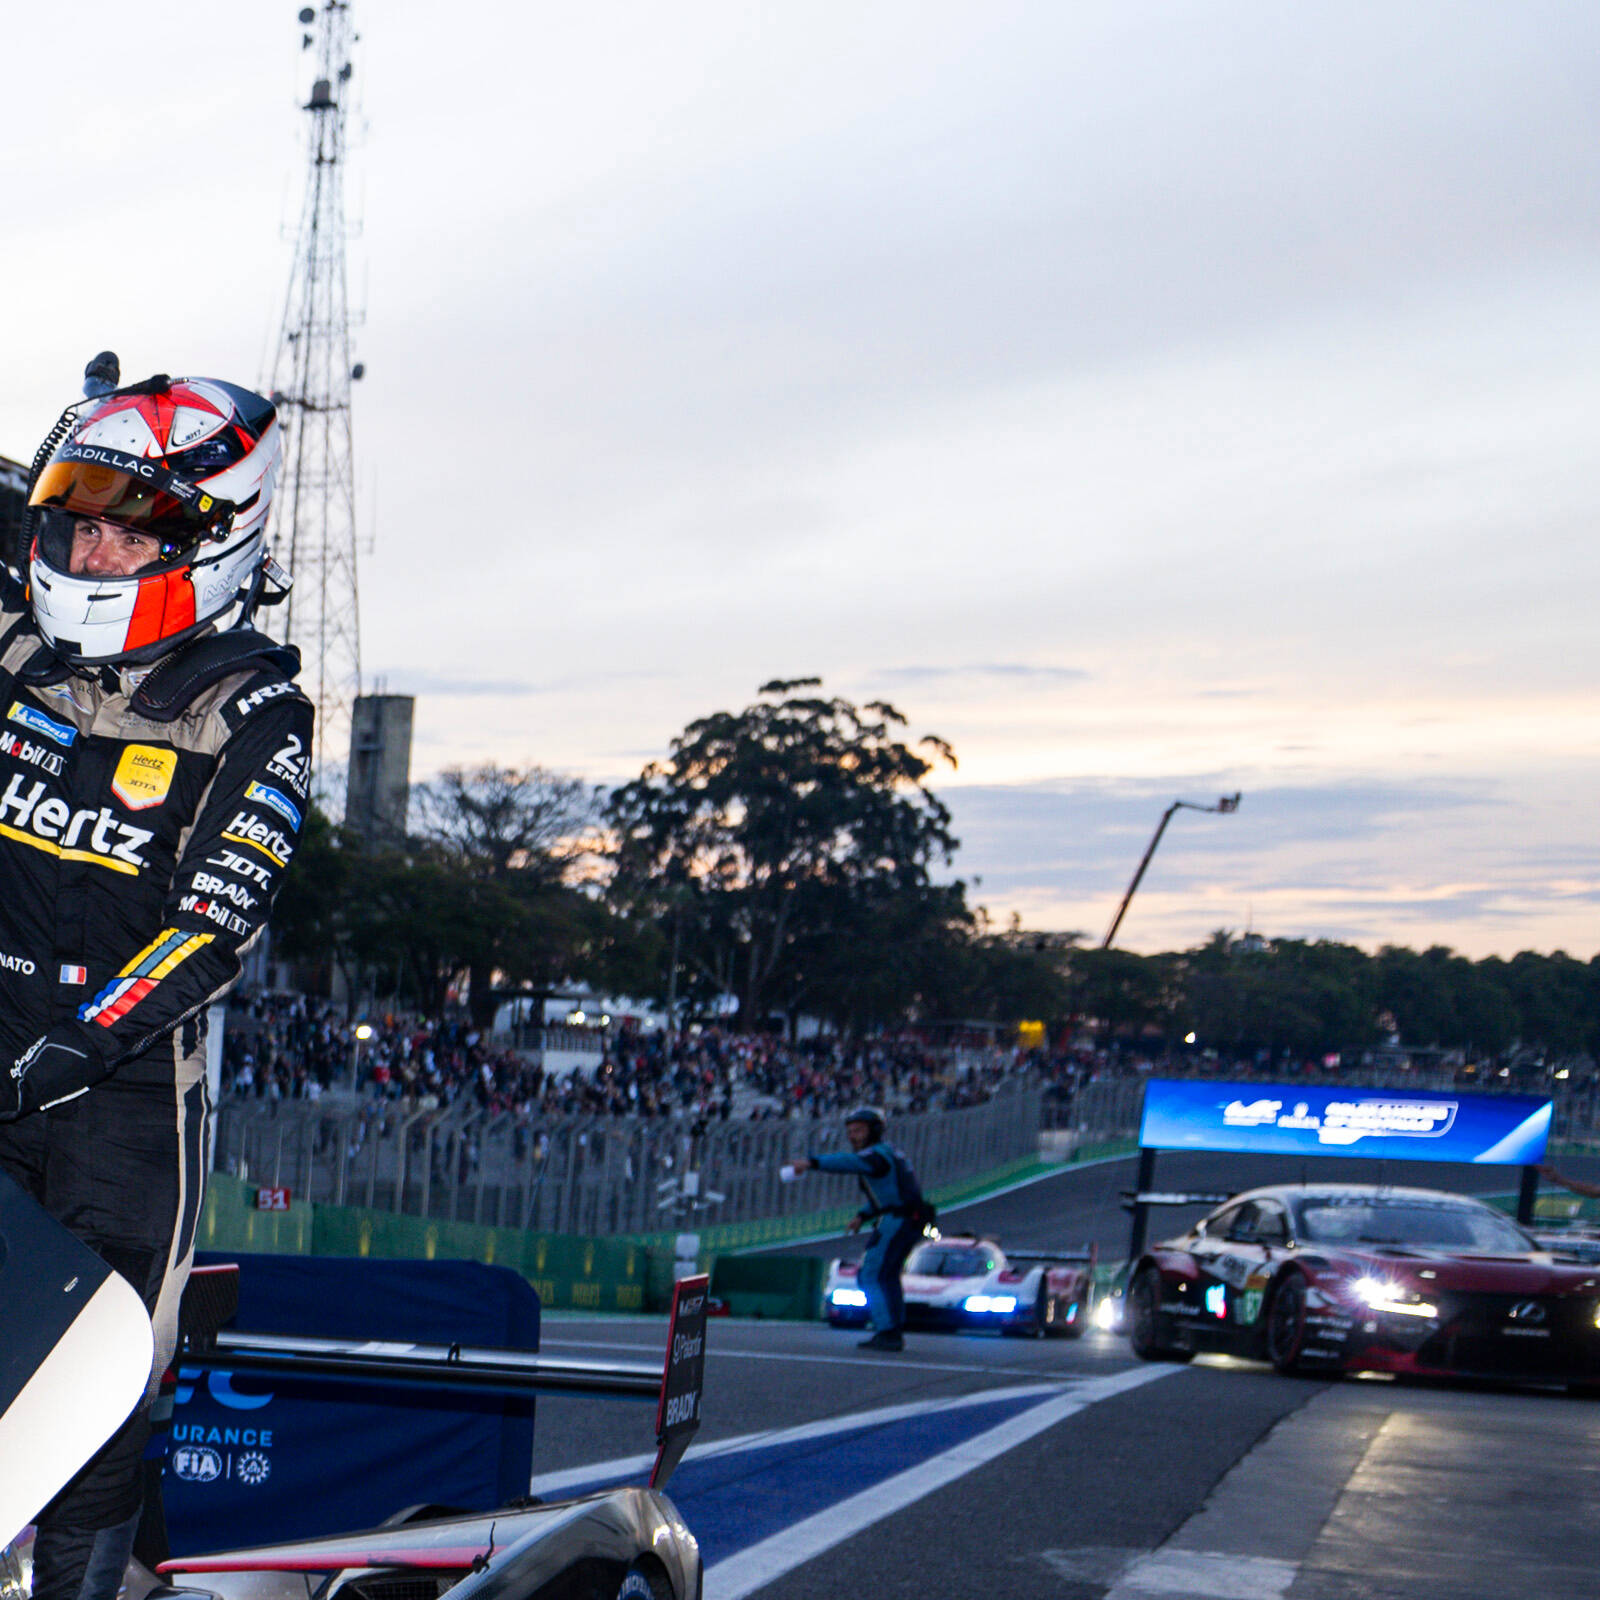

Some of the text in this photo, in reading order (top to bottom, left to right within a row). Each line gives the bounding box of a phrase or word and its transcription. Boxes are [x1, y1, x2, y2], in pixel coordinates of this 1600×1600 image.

[62, 446, 155, 478] CADILLAC
[237, 682, 296, 716] HRX
[133, 753, 165, 770] Hertz
[226, 811, 293, 864] Hertz
[178, 894, 230, 927] Mobil
[173, 1423, 273, 1447] URANCE
